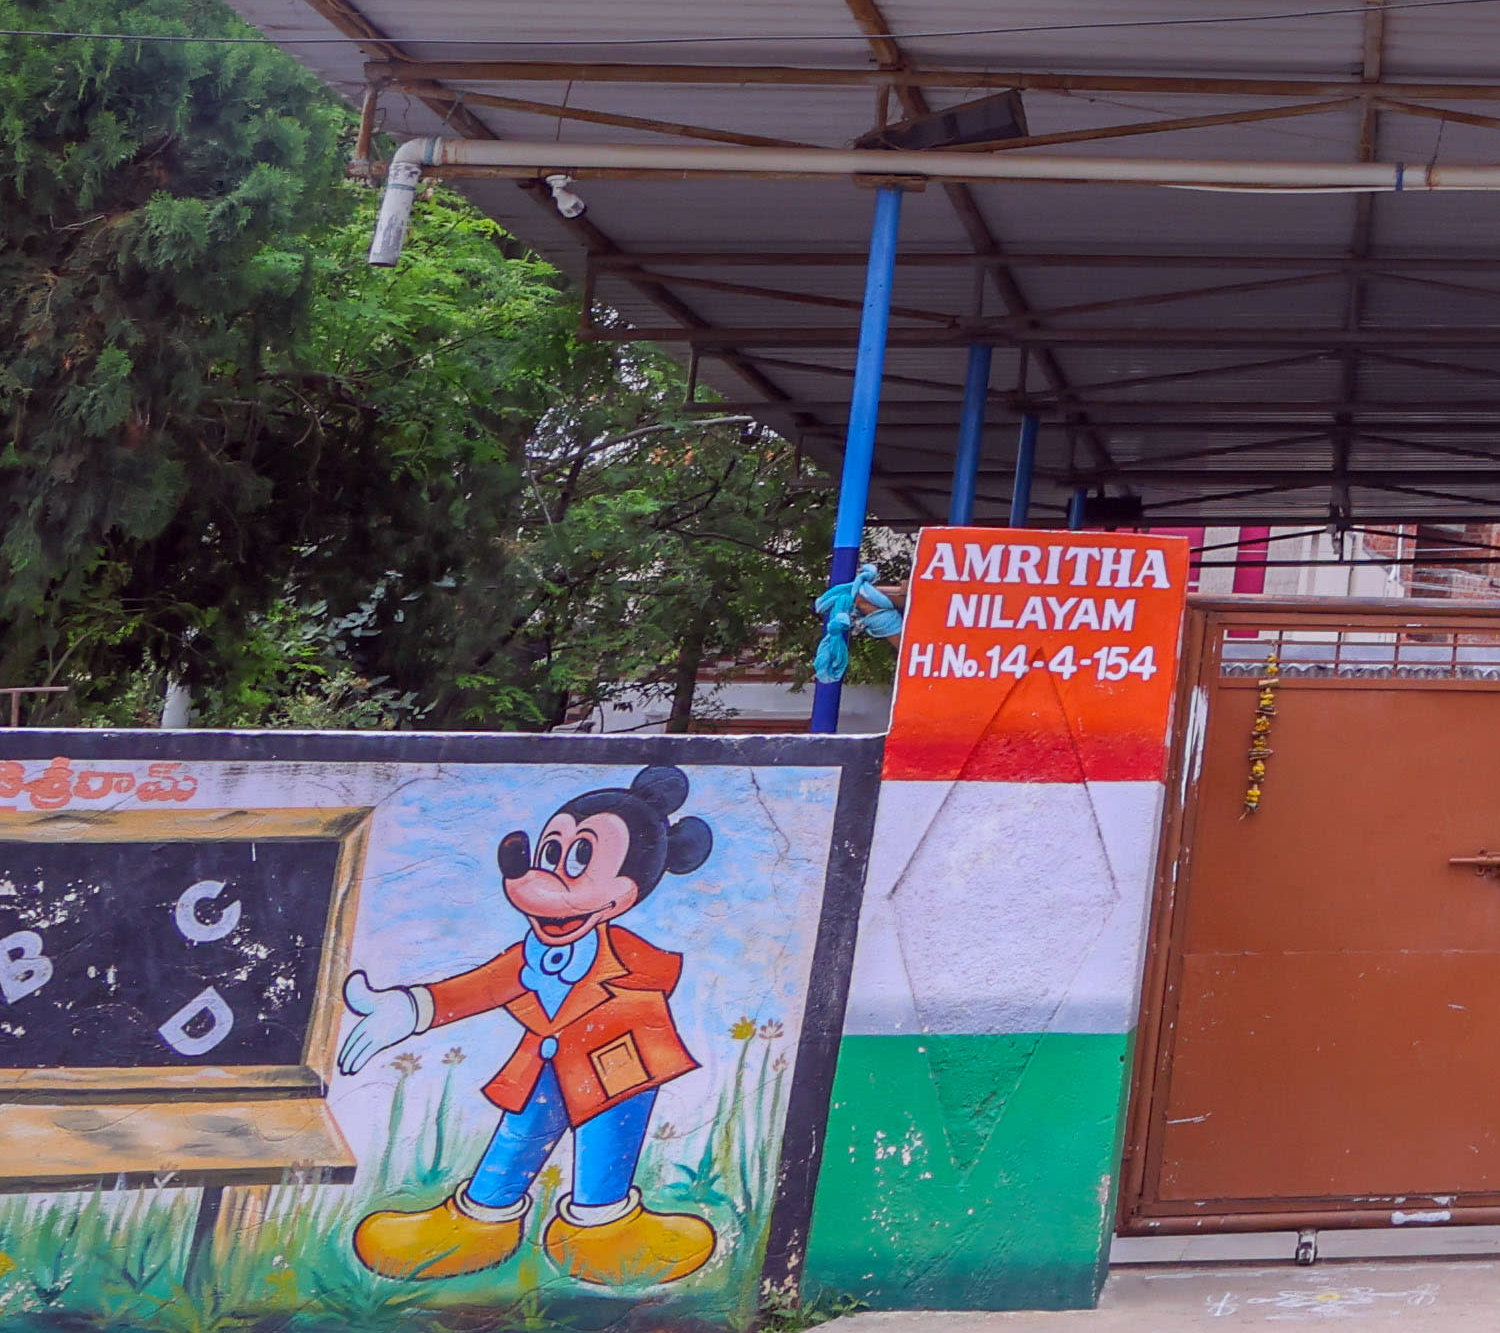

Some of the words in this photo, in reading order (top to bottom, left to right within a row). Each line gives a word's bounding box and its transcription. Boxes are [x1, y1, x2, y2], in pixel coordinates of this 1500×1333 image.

[921, 541, 1171, 590] AMRITHA
[946, 593, 1137, 633] NILAYAM
[175, 879, 242, 944] C
[157, 985, 235, 1057] D
